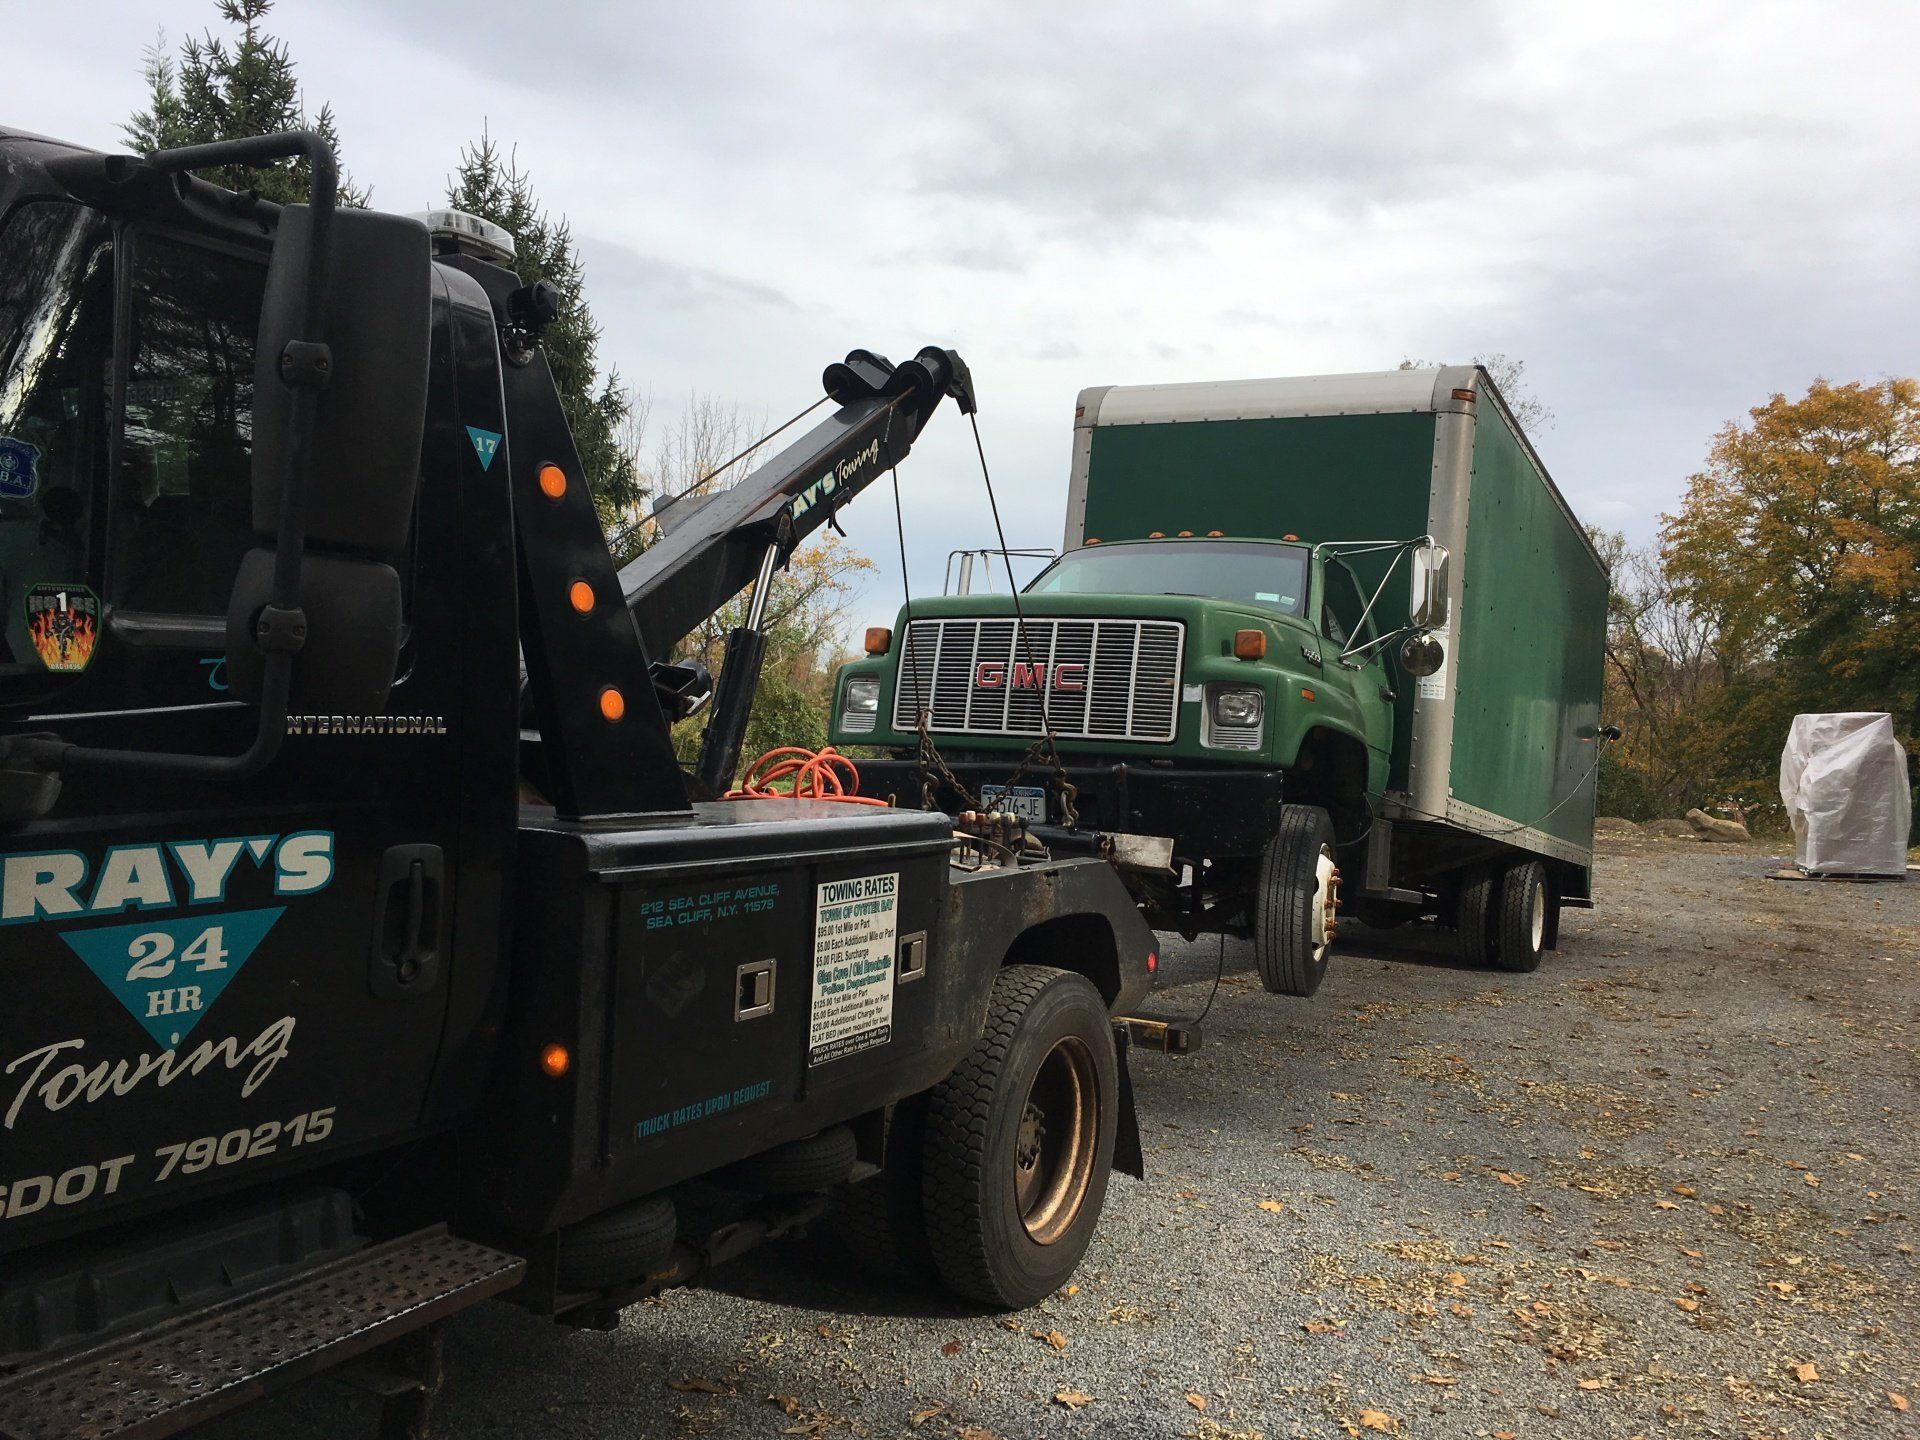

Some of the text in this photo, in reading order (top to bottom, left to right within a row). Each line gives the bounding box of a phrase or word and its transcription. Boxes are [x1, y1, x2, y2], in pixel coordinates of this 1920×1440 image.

[476, 436, 496, 454] 17
[789, 438, 879, 521] AY'S Towing
[976, 662, 1085, 690] GMC
[286, 715, 447, 735] NTERNATIONAL
[0, 829, 335, 925] RAY'S
[822, 875, 895, 903] TOWING RATES
[640, 883, 780, 915] 212 SEA CLIFF AVENUE,
[820, 898, 895, 924] TOWN OF OYSTER BAY
[646, 899, 774, 930] SEA CLIFF, N.Y. 11579
[817, 919, 870, 939] $95.00 1st Mile or Part
[817, 928, 894, 954] $5.00 Each Additional Mile or Part
[125, 926, 229, 983] 24
[816, 948, 869, 968] $5.00 FUEL Surcharge
[817, 969, 832, 986] Glen
[833, 966, 849, 982] Cove
[852, 960, 863, 977] Old
[863, 954, 892, 975] Brookville
[821, 971, 887, 997] Police Department
[145, 984, 204, 1018] HR
[812, 1009, 827, 1021] $5.00
[827, 1007, 840, 1018] Each
[840, 1001, 864, 1014] Additional
[864, 998, 874, 1008] Mile
[880, 994, 890, 1003] Part
[813, 997, 833, 1010] $125.00
[833, 996, 841, 1004] 1st
[842, 992, 851, 1002] Mile
[858, 989, 868, 999] Part
[811, 1032, 825, 1045] FLAT
[825, 1029, 837, 1040] BED
[852, 1018, 871, 1033] required
[812, 1005, 884, 1033] $20.00 Additional Charge for
[812, 1046, 829, 1056] TRUCK
[829, 1040, 845, 1051] RATES
[855, 1035, 864, 1043] One
[813, 1054, 823, 1064] And
[830, 1049, 844, 1058] Other
[869, 1034, 887, 1046] Request
[4, 1015, 297, 1130] Towing
[636, 1080, 772, 1138] TRUCK RATES UPON REQUEST
[154, 1106, 337, 1183] 790215
